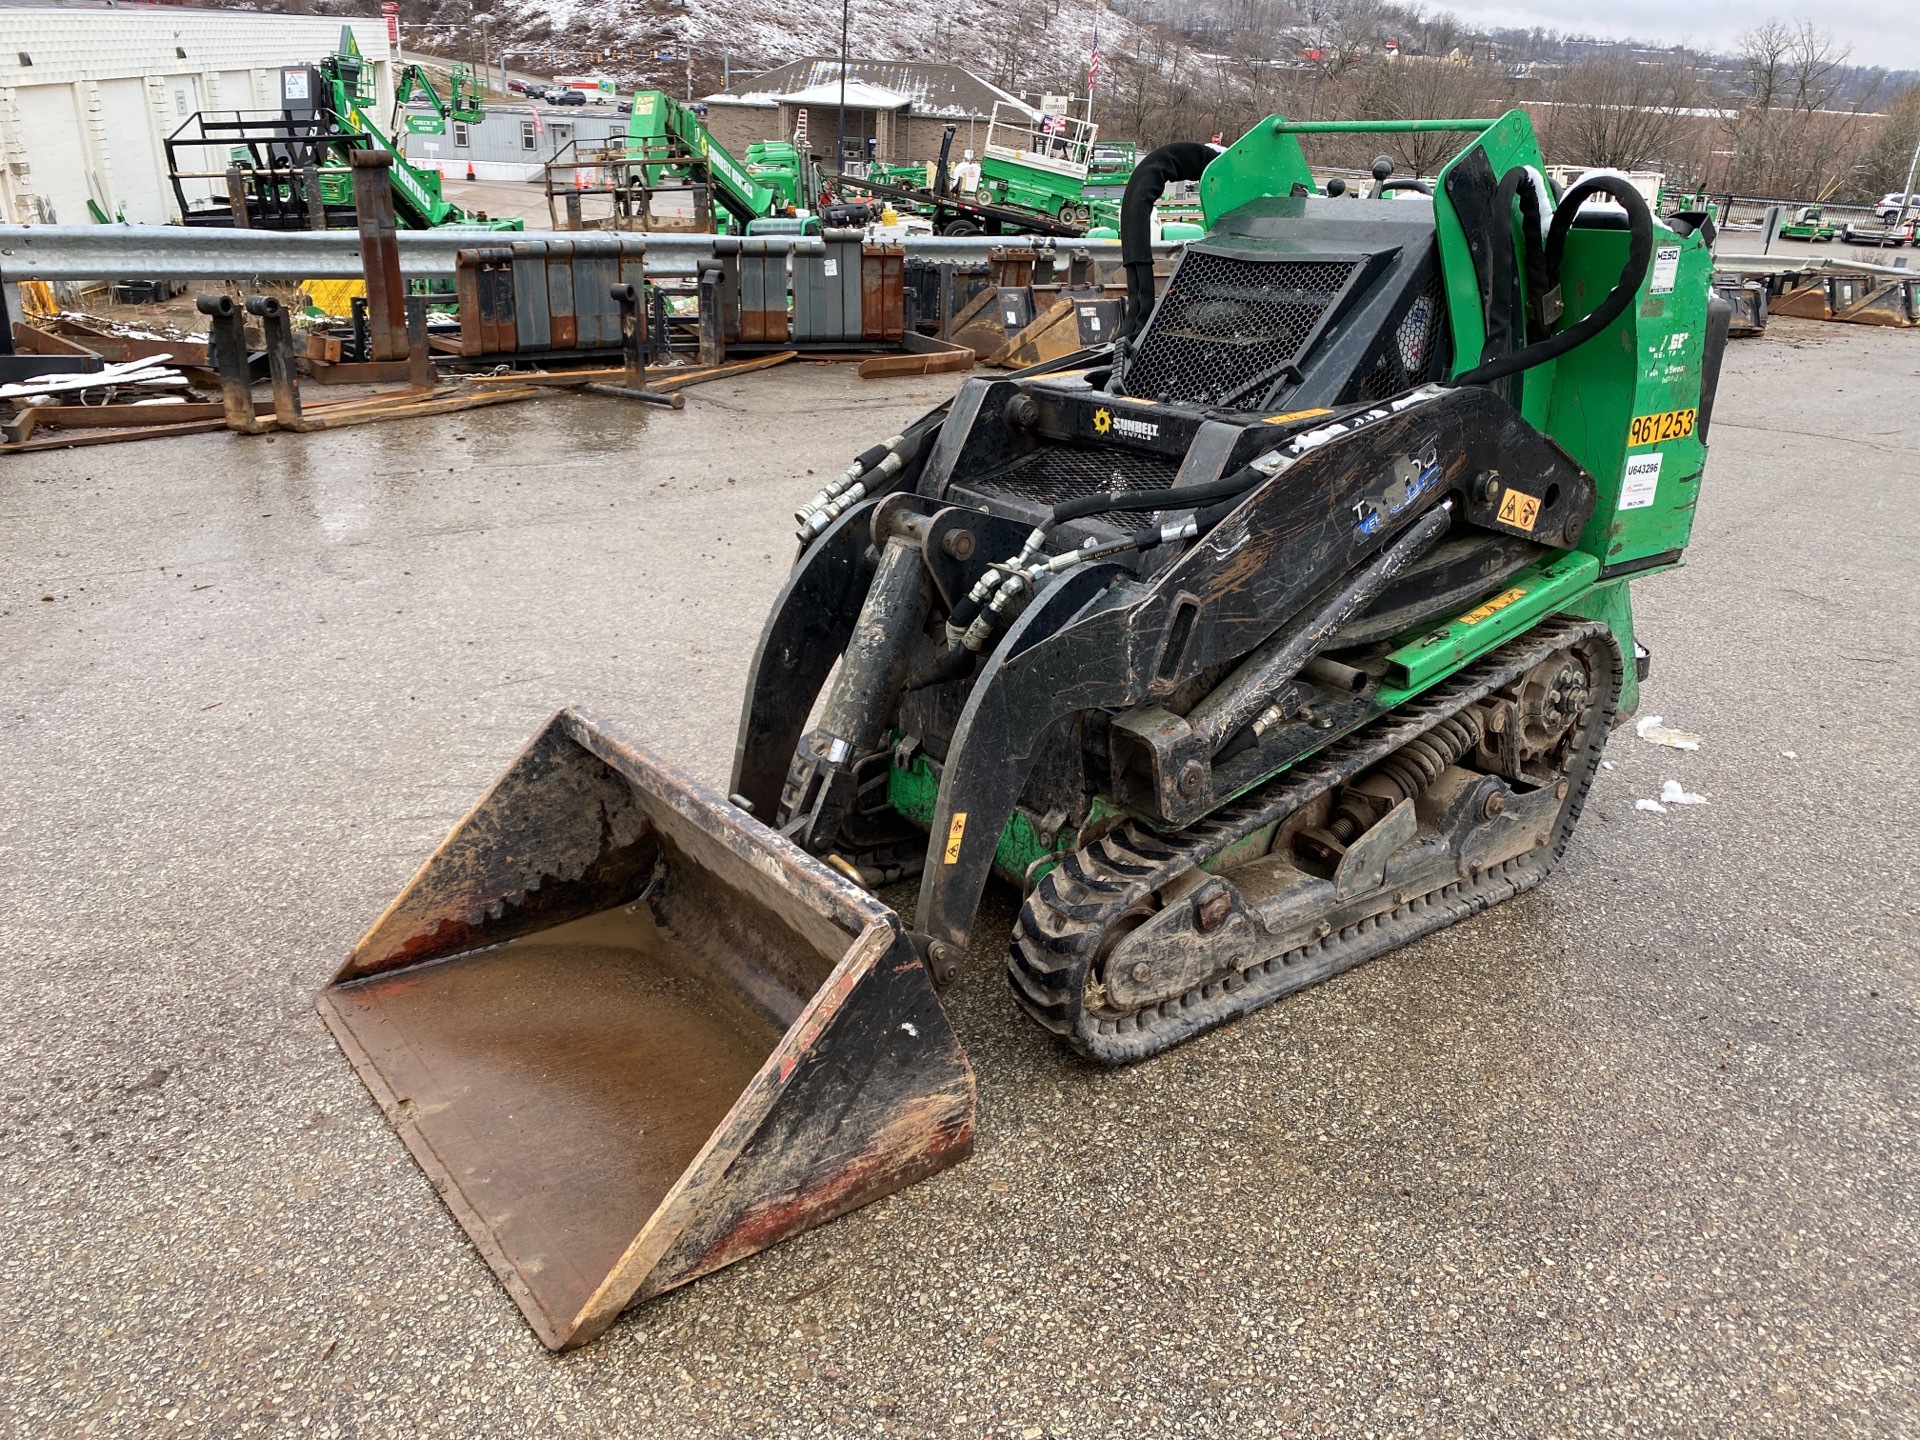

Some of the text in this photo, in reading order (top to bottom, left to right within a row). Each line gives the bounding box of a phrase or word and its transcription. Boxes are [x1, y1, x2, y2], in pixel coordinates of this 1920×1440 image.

[398, 163, 431, 211] RENTALS
[1112, 416, 1159, 437] SUNBELT
[1118, 429, 1152, 441] RENTALS
[1631, 409, 1695, 445] 961253
[1627, 462, 1659, 476] U643296
